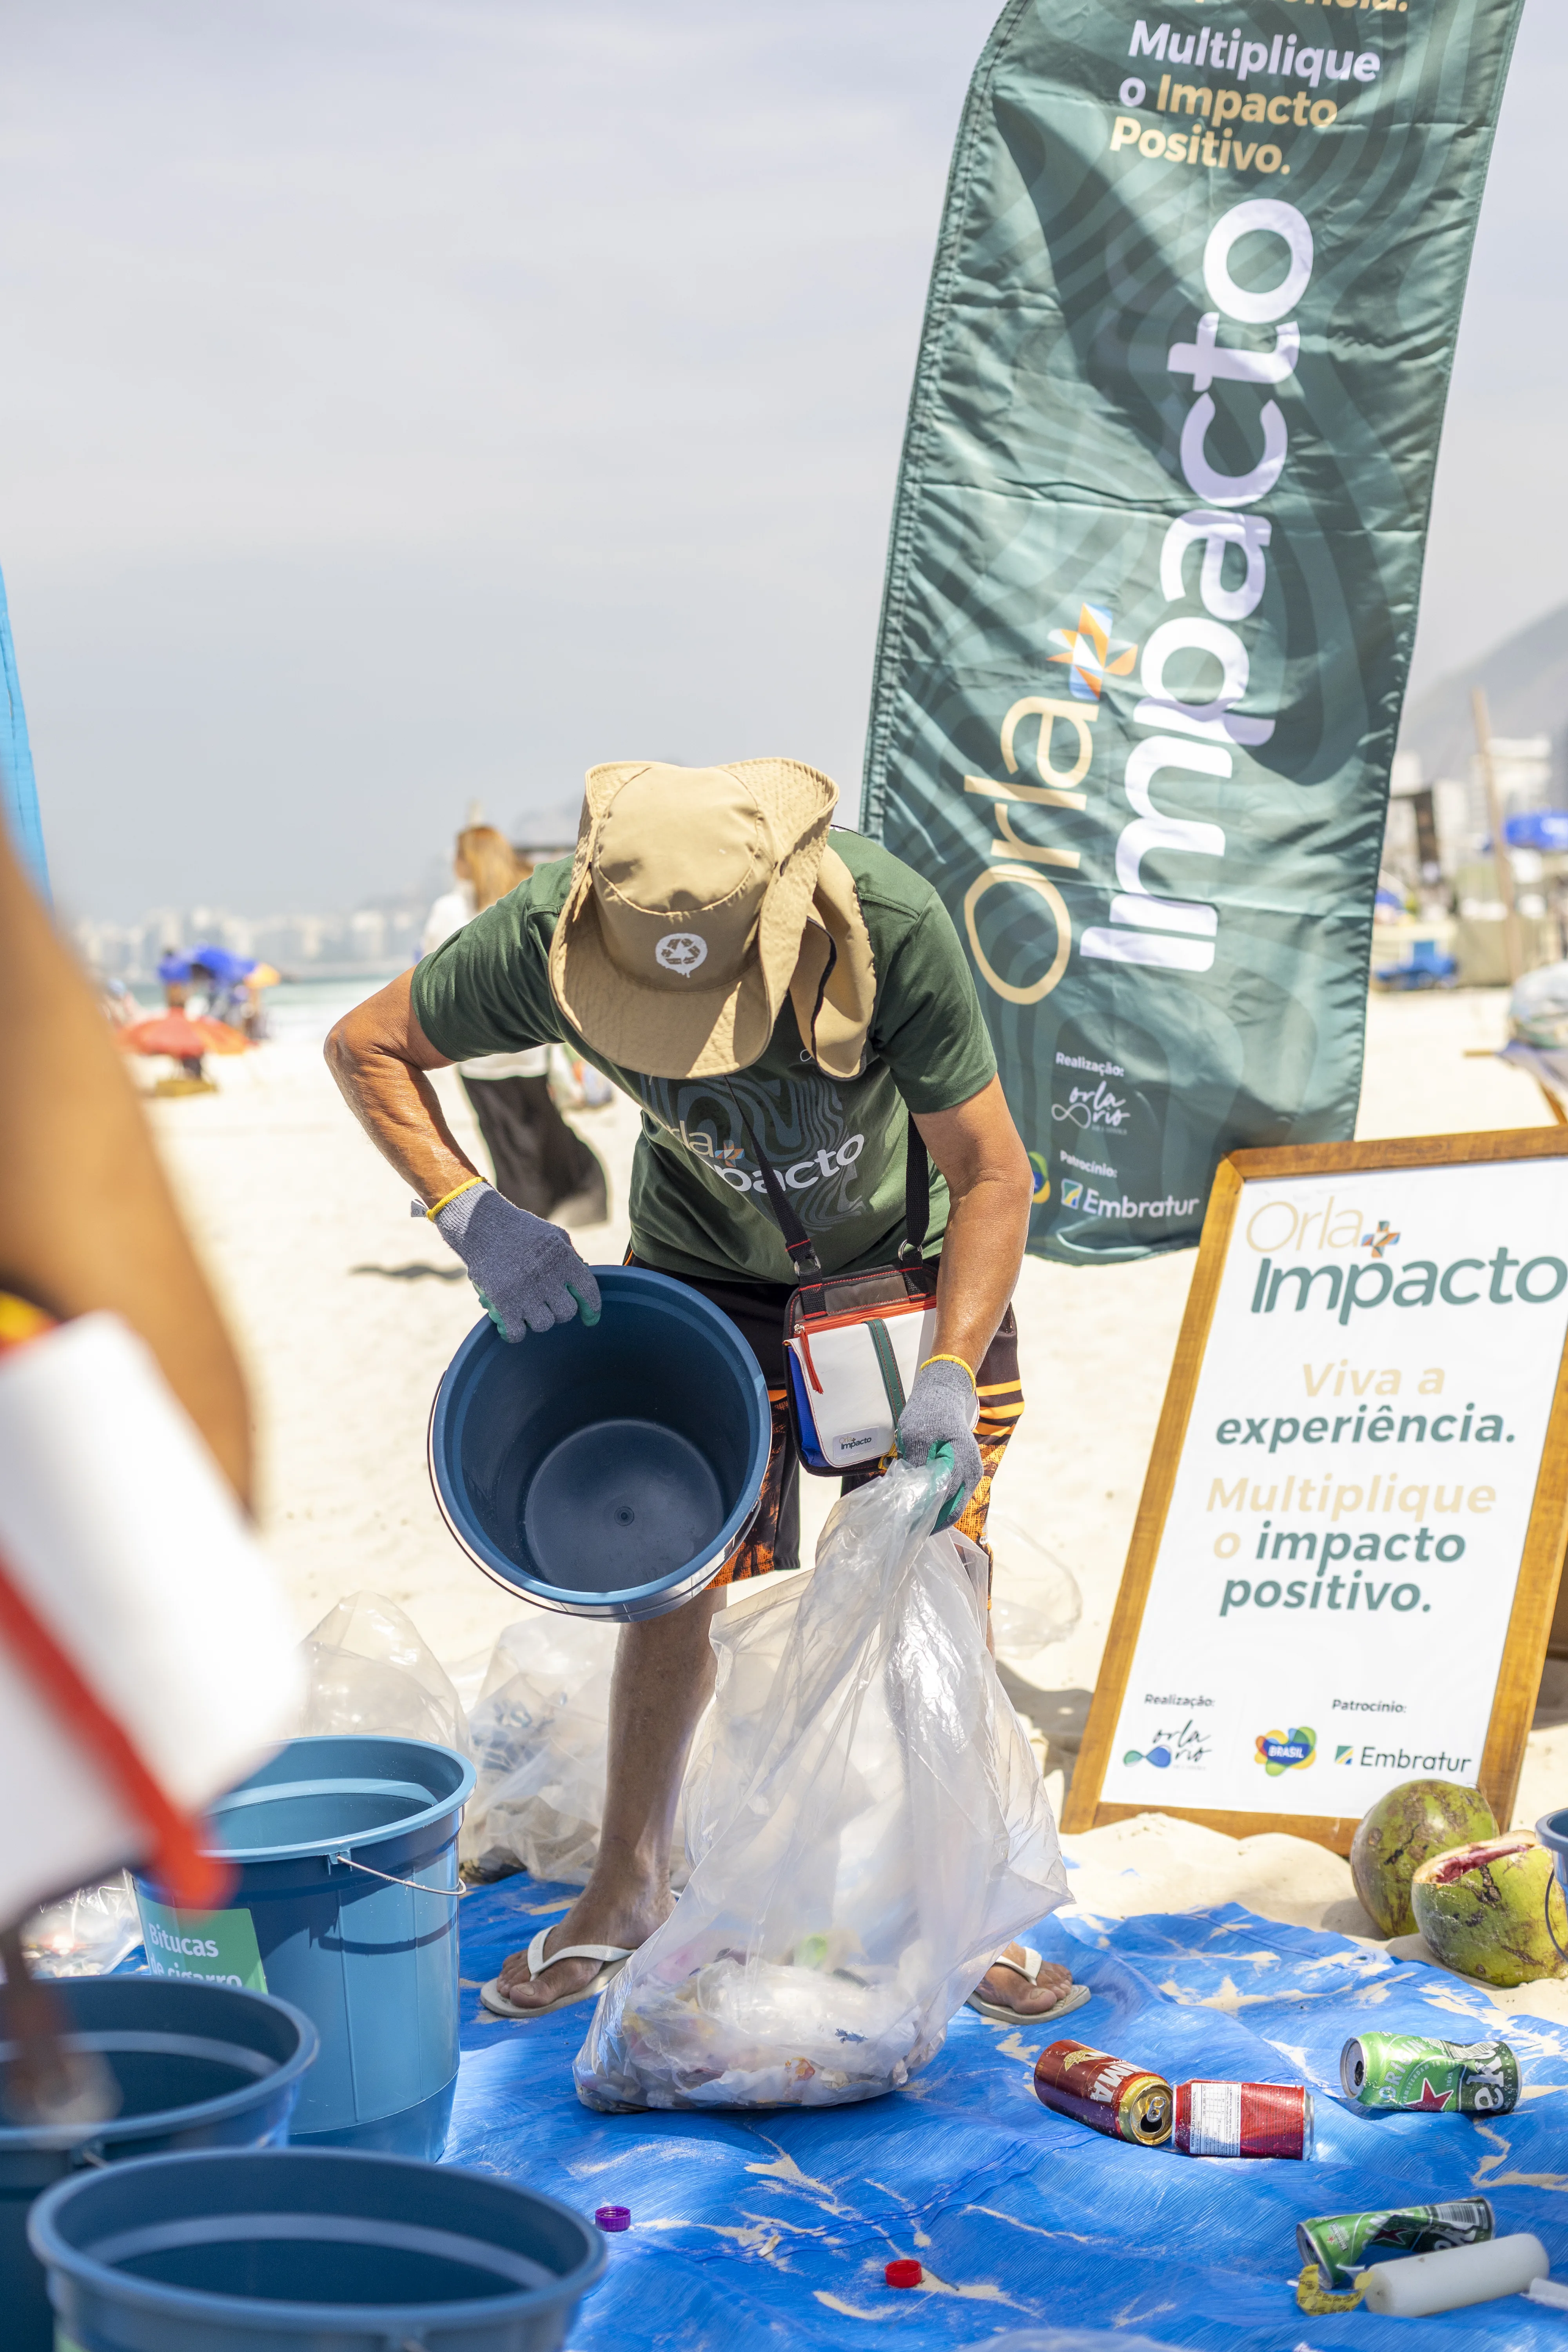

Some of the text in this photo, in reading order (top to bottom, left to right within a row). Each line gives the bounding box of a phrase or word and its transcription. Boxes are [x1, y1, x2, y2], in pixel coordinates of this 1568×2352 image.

[1128, 19, 1381, 87] Multiplique
[1118, 74, 1338, 129] o Impacto
[1109, 116, 1290, 175] Positivo.
[1079, 198, 1315, 973] Impacto
[964, 696, 1099, 1005] Orla
[1056, 1052, 1125, 1076] Realização:
[1069, 1081, 1126, 1111] orla
[1093, 1107, 1131, 1126] rio
[667, 1120, 714, 1158] rla
[713, 1134, 864, 1193] pacto
[1060, 1150, 1118, 1178] Patrocínio:
[1083, 1188, 1200, 1219] Embratur
[1247, 1196, 1364, 1253] Orla
[1251, 1247, 1568, 1325] Impacto
[1303, 1359, 1446, 1397] Viva a
[841, 1437, 871, 1450] Impacto
[1216, 1403, 1515, 1454] experiência.
[1207, 1473, 1496, 1522] Multiplique
[1213, 1520, 1466, 1577] o impacto
[1220, 1570, 1431, 1617] positivo.
[1144, 1694, 1215, 1709] Realização:
[1332, 1699, 1406, 1713] Patrocínio:
[1153, 1719, 1211, 1747] orla
[1268, 1745, 1304, 1759] BRASIL
[1175, 1745, 1212, 1762] rio
[1361, 1746, 1472, 1773] Embratur
[149, 1922, 218, 1957] Bitucas
